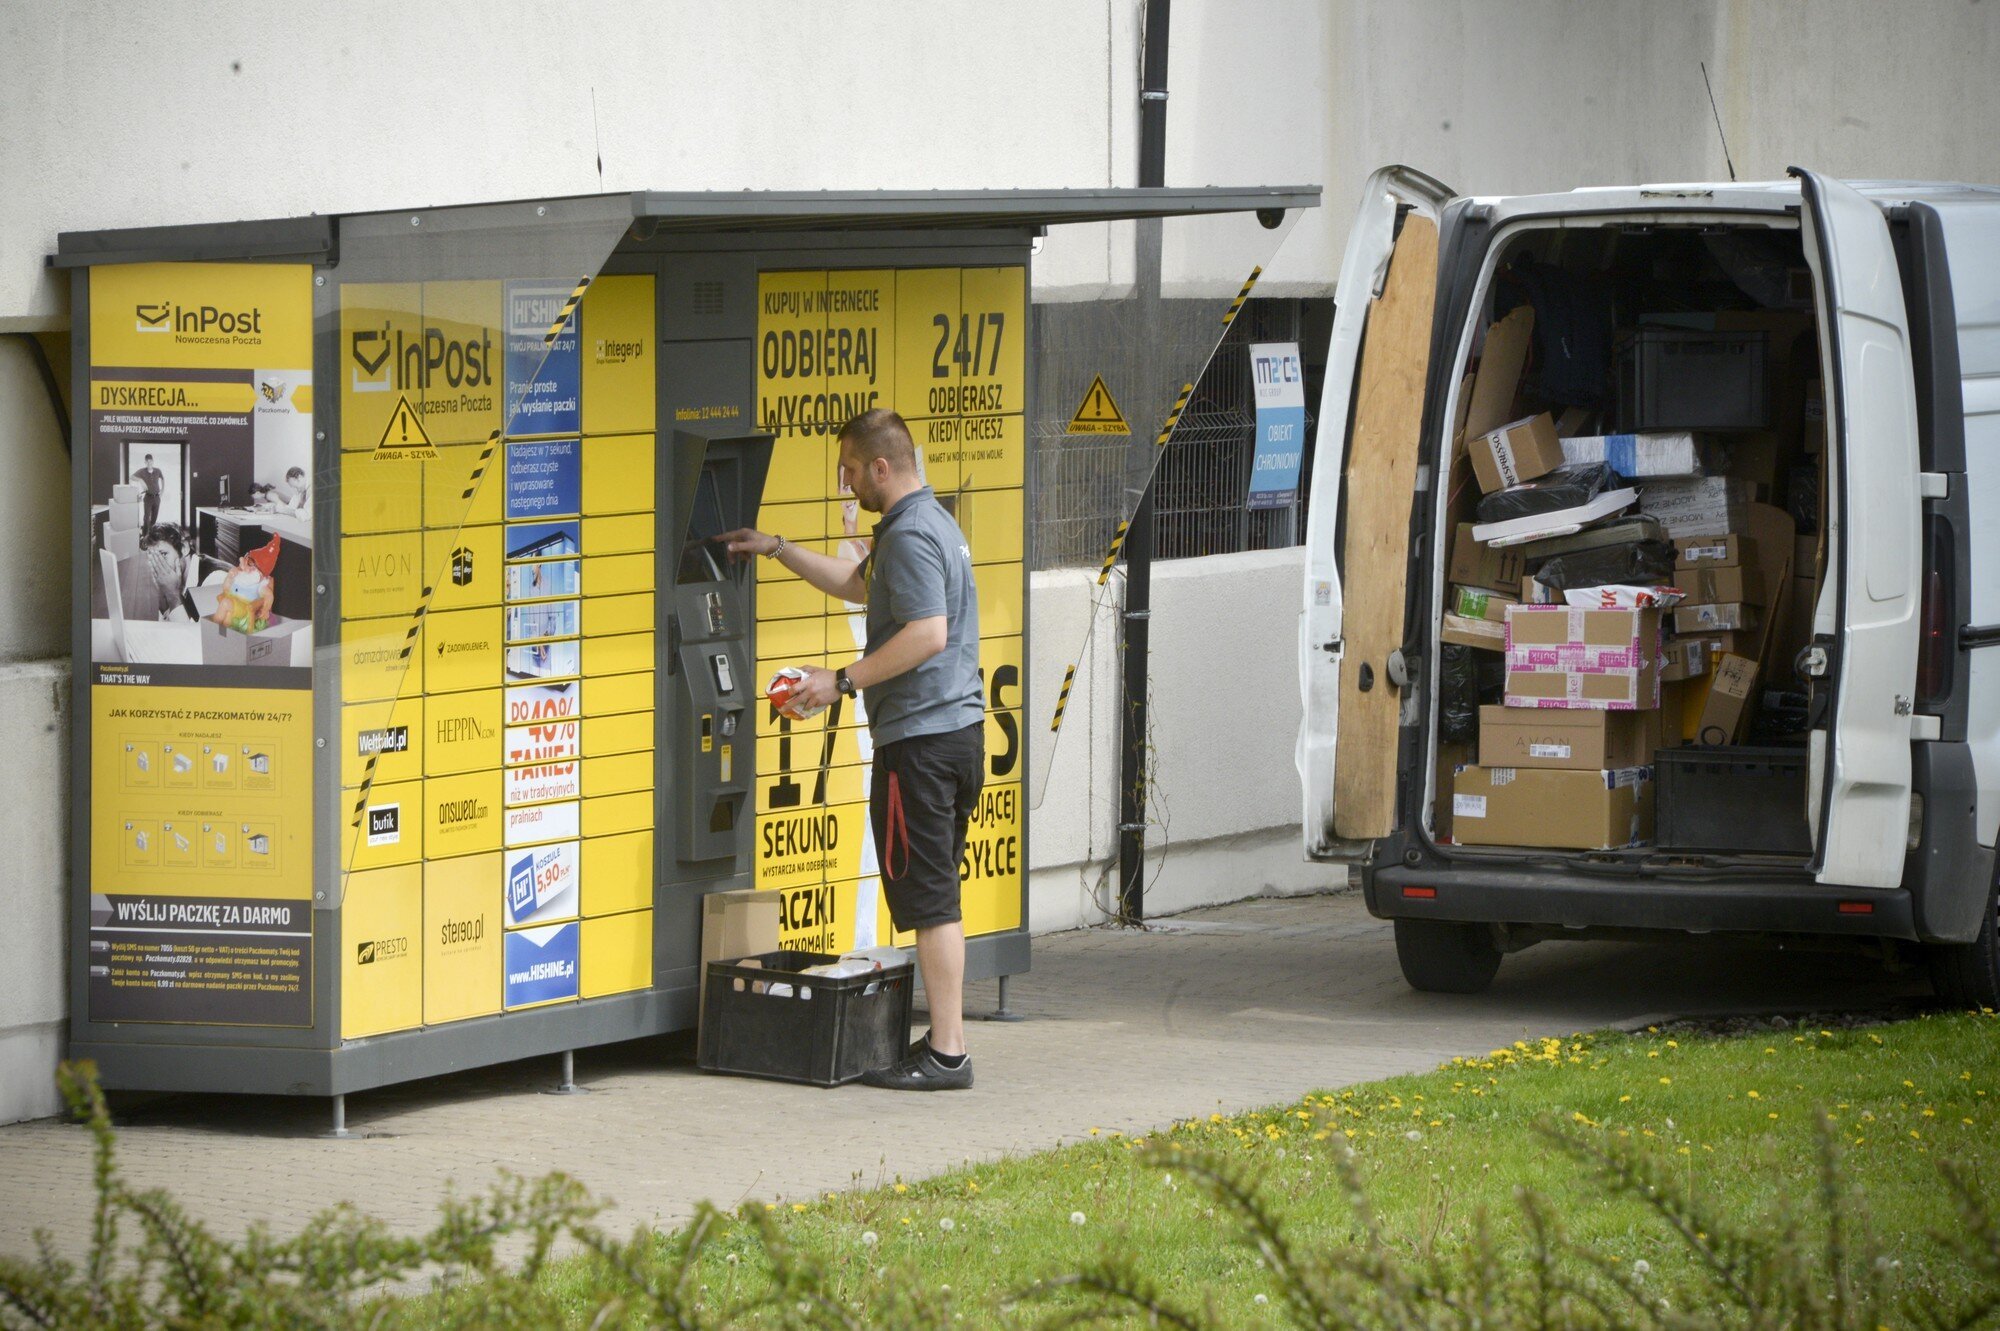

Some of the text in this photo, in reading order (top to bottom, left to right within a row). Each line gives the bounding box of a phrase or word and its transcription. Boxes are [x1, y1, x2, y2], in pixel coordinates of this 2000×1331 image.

[764, 288, 879, 318] KUPUJ W INTERNECIE
[175, 306, 262, 334] InPost
[175, 334, 262, 346] Nowoczesna Poczta
[562, 339, 576, 353] 24/7
[932, 312, 1005, 379] 24/7
[396, 327, 492, 390] InPost
[605, 338, 643, 363] Integer.pl
[762, 327, 877, 386] ODBIERAJ
[100, 386, 199, 408] DYSKRECJA...
[509, 380, 558, 396] Pranie proste
[409, 393, 492, 416] woczesna Poczta
[508, 397, 576, 417] jak wysłanie paczki
[928, 383, 1003, 414] ODBIERASZ
[143, 415, 152, 424] NIE
[152, 415, 169, 425] KAŻDY
[169, 416, 183, 425] MUSI
[209, 417, 217, 426] CO
[257, 406, 291, 415] Paczkomaty
[125, 424, 141, 434] PRZEZ
[141, 425, 176, 435] PACZKOMATY
[928, 416, 1003, 444] KIEDY CHCESZ
[1069, 423, 1097, 433] UWAGA
[1102, 423, 1128, 433] SZYBA
[1268, 424, 1295, 443] OBIEKT
[373, 450, 403, 461] UWAGA
[410, 449, 438, 460] SZYBA
[510, 443, 572, 458] Nadajesz w 7 sekund,
[928, 452, 946, 464] NAWET
[946, 452, 952, 463] W
[952, 451, 969, 462] NOCY
[976, 450, 986, 461] DNI
[985, 448, 1003, 460] WOLNE
[510, 461, 559, 476] odbierasz czyste
[1256, 451, 1300, 471] CHRONIONY
[513, 478, 554, 494] wyprasowane
[510, 493, 559, 510] następnego dnia
[357, 552, 413, 579] AVON
[446, 640, 490, 654] ZADOWOLENIE.PL
[1531, 651, 1557, 663] butik
[100, 674, 151, 685] THAT'S THE WAY
[108, 708, 293, 723] JAK KORZYSTAĆ Z PACZKOMATÓW 24/7?
[511, 696, 576, 744] DO 40%
[436, 716, 496, 744] HEPPIN.COM
[1515, 736, 1570, 748] AVON
[510, 743, 575, 782] TANIEJ
[510, 780, 575, 802] niż w tradycyjnych
[438, 798, 488, 825] answear.com
[510, 809, 543, 828] pralniach
[967, 789, 1016, 829] UJĄCEJ
[373, 814, 394, 831] butik
[763, 813, 838, 859] SEKUND
[535, 848, 561, 872] KOSZULE
[762, 858, 838, 878] WYSTARCZA NA ODEBRANIE
[961, 835, 1016, 882] SYŁCE
[536, 863, 560, 893] 5,90
[117, 900, 291, 927] WYŚLIJ PACZKĘ ZA DARMO
[779, 885, 835, 932] ACZKI
[376, 936, 408, 956] PRESTO
[509, 959, 575, 986] www.HISHINE.pl
